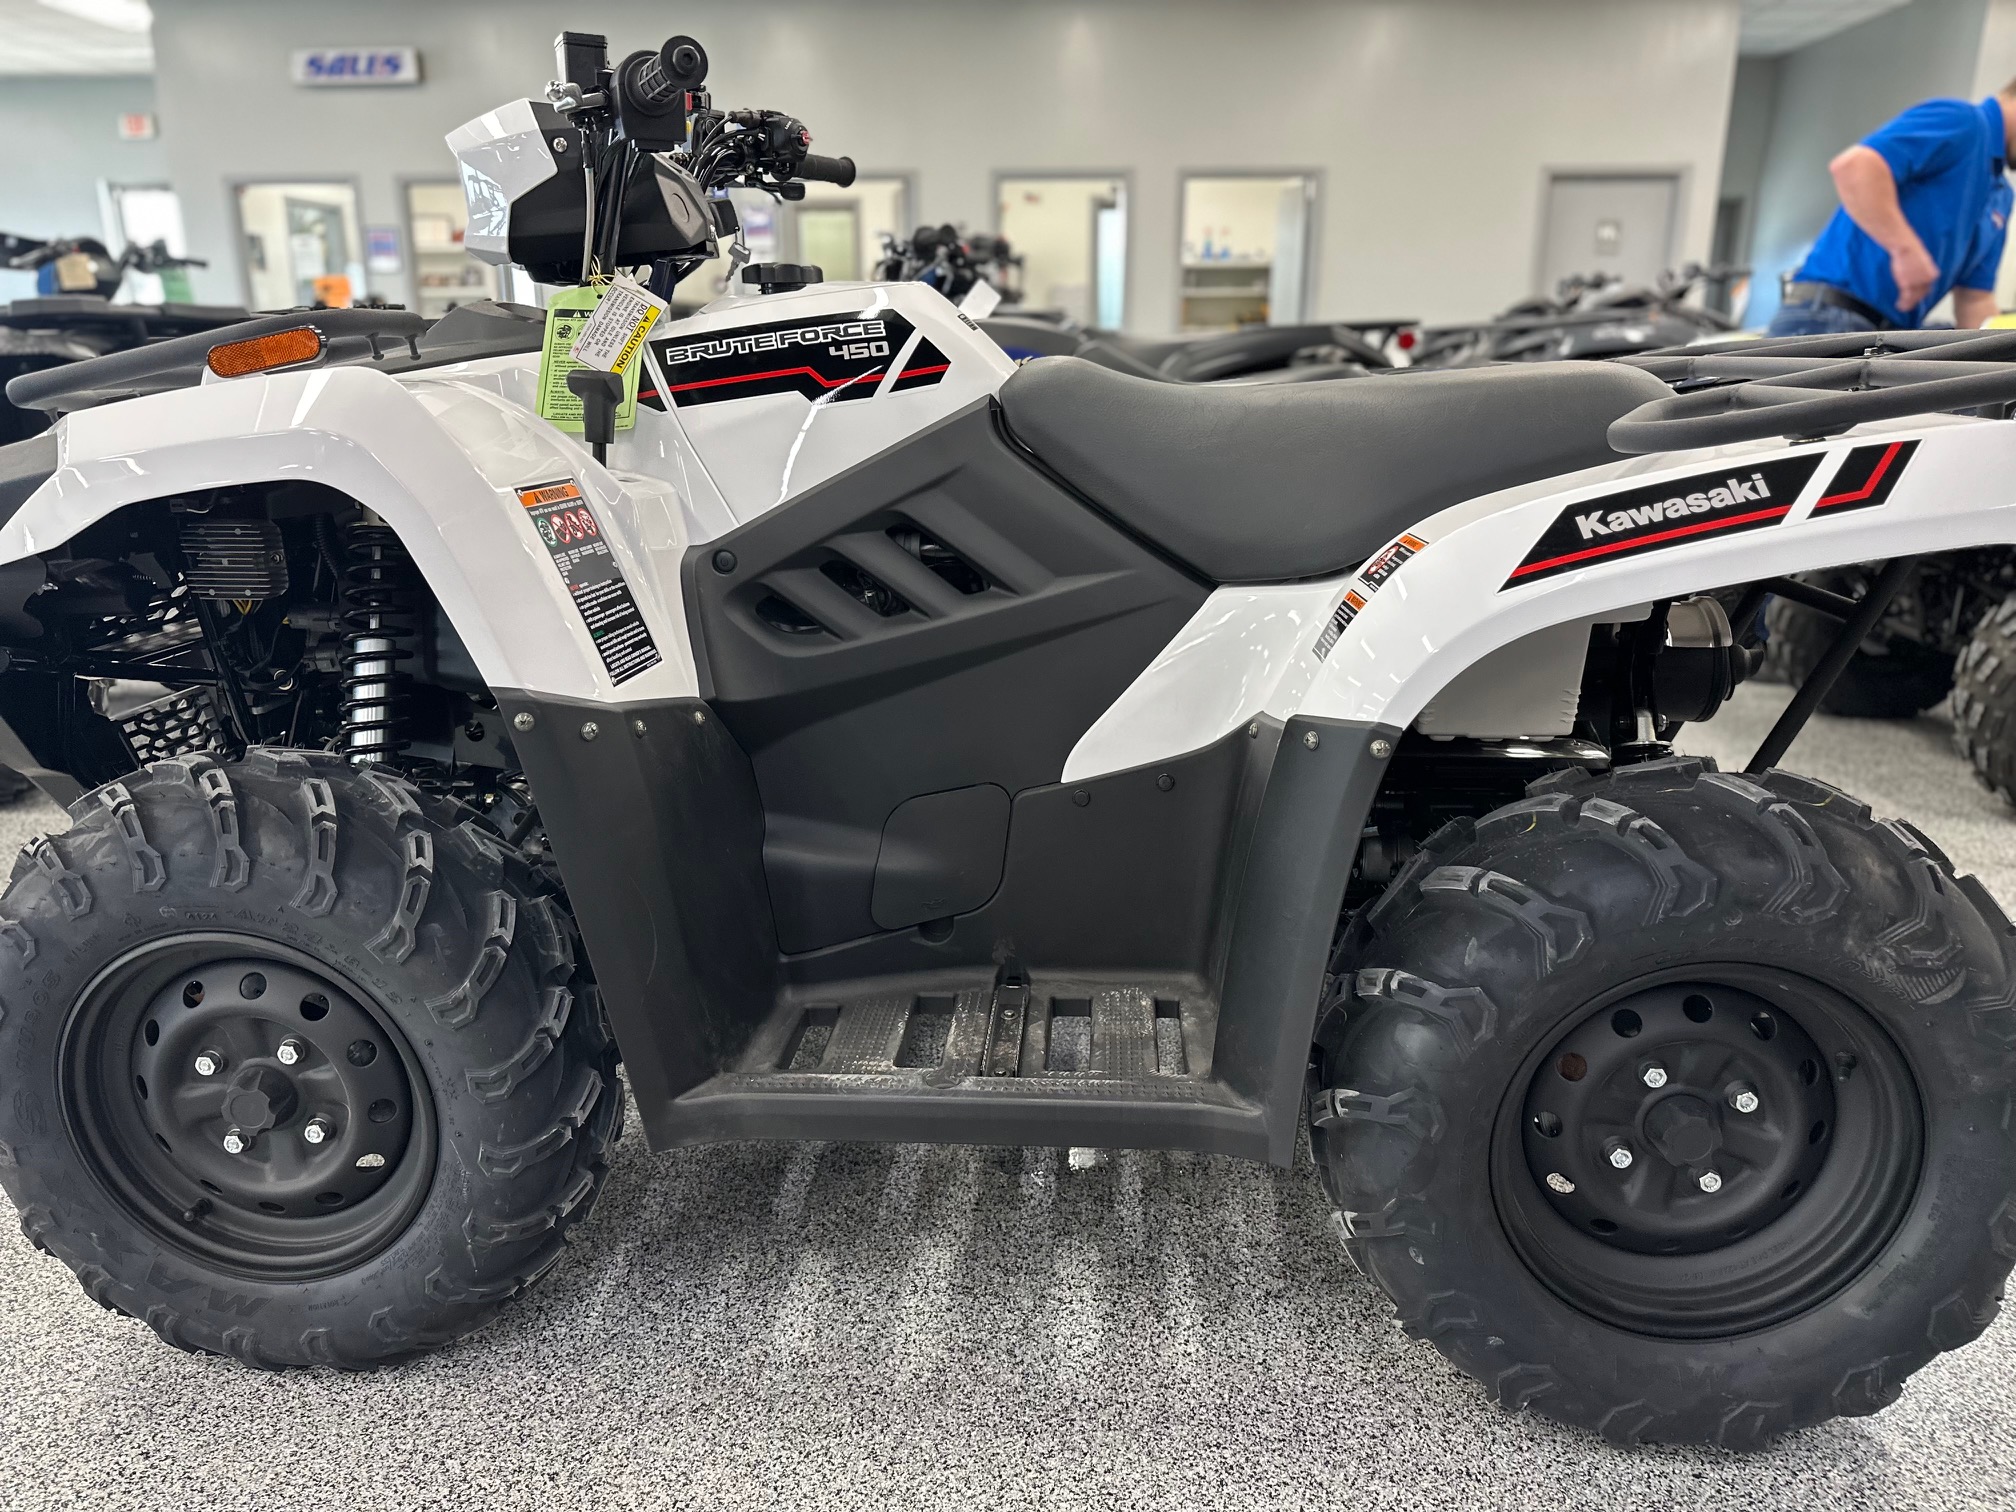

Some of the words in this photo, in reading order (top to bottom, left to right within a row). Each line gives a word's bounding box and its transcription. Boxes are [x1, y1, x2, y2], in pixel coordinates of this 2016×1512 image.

[602, 290, 623, 320] TRANSMISSION
[615, 293, 628, 310] VEHICLE
[622, 296, 634, 312] ENGINE
[636, 303, 648, 315] DO
[619, 300, 640, 330] TRANSMISSION
[626, 315, 640, 332] NOT
[590, 321, 603, 340] DAMAGE
[599, 318, 613, 337] STOPPED
[583, 341, 592, 351] WILL
[601, 337, 609, 347] AND
[608, 331, 620, 347] UNLESS
[616, 325, 645, 368] CAUTION
[618, 333, 627, 345] SHIFT
[665, 335, 777, 366] BRUTE
[775, 320, 886, 350] FORCE
[595, 348, 603, 357] THE
[602, 349, 610, 358] THE
[829, 340, 890, 361] 450
[538, 486, 570, 501] WARNING
[1574, 473, 1772, 540] Kawasaki
